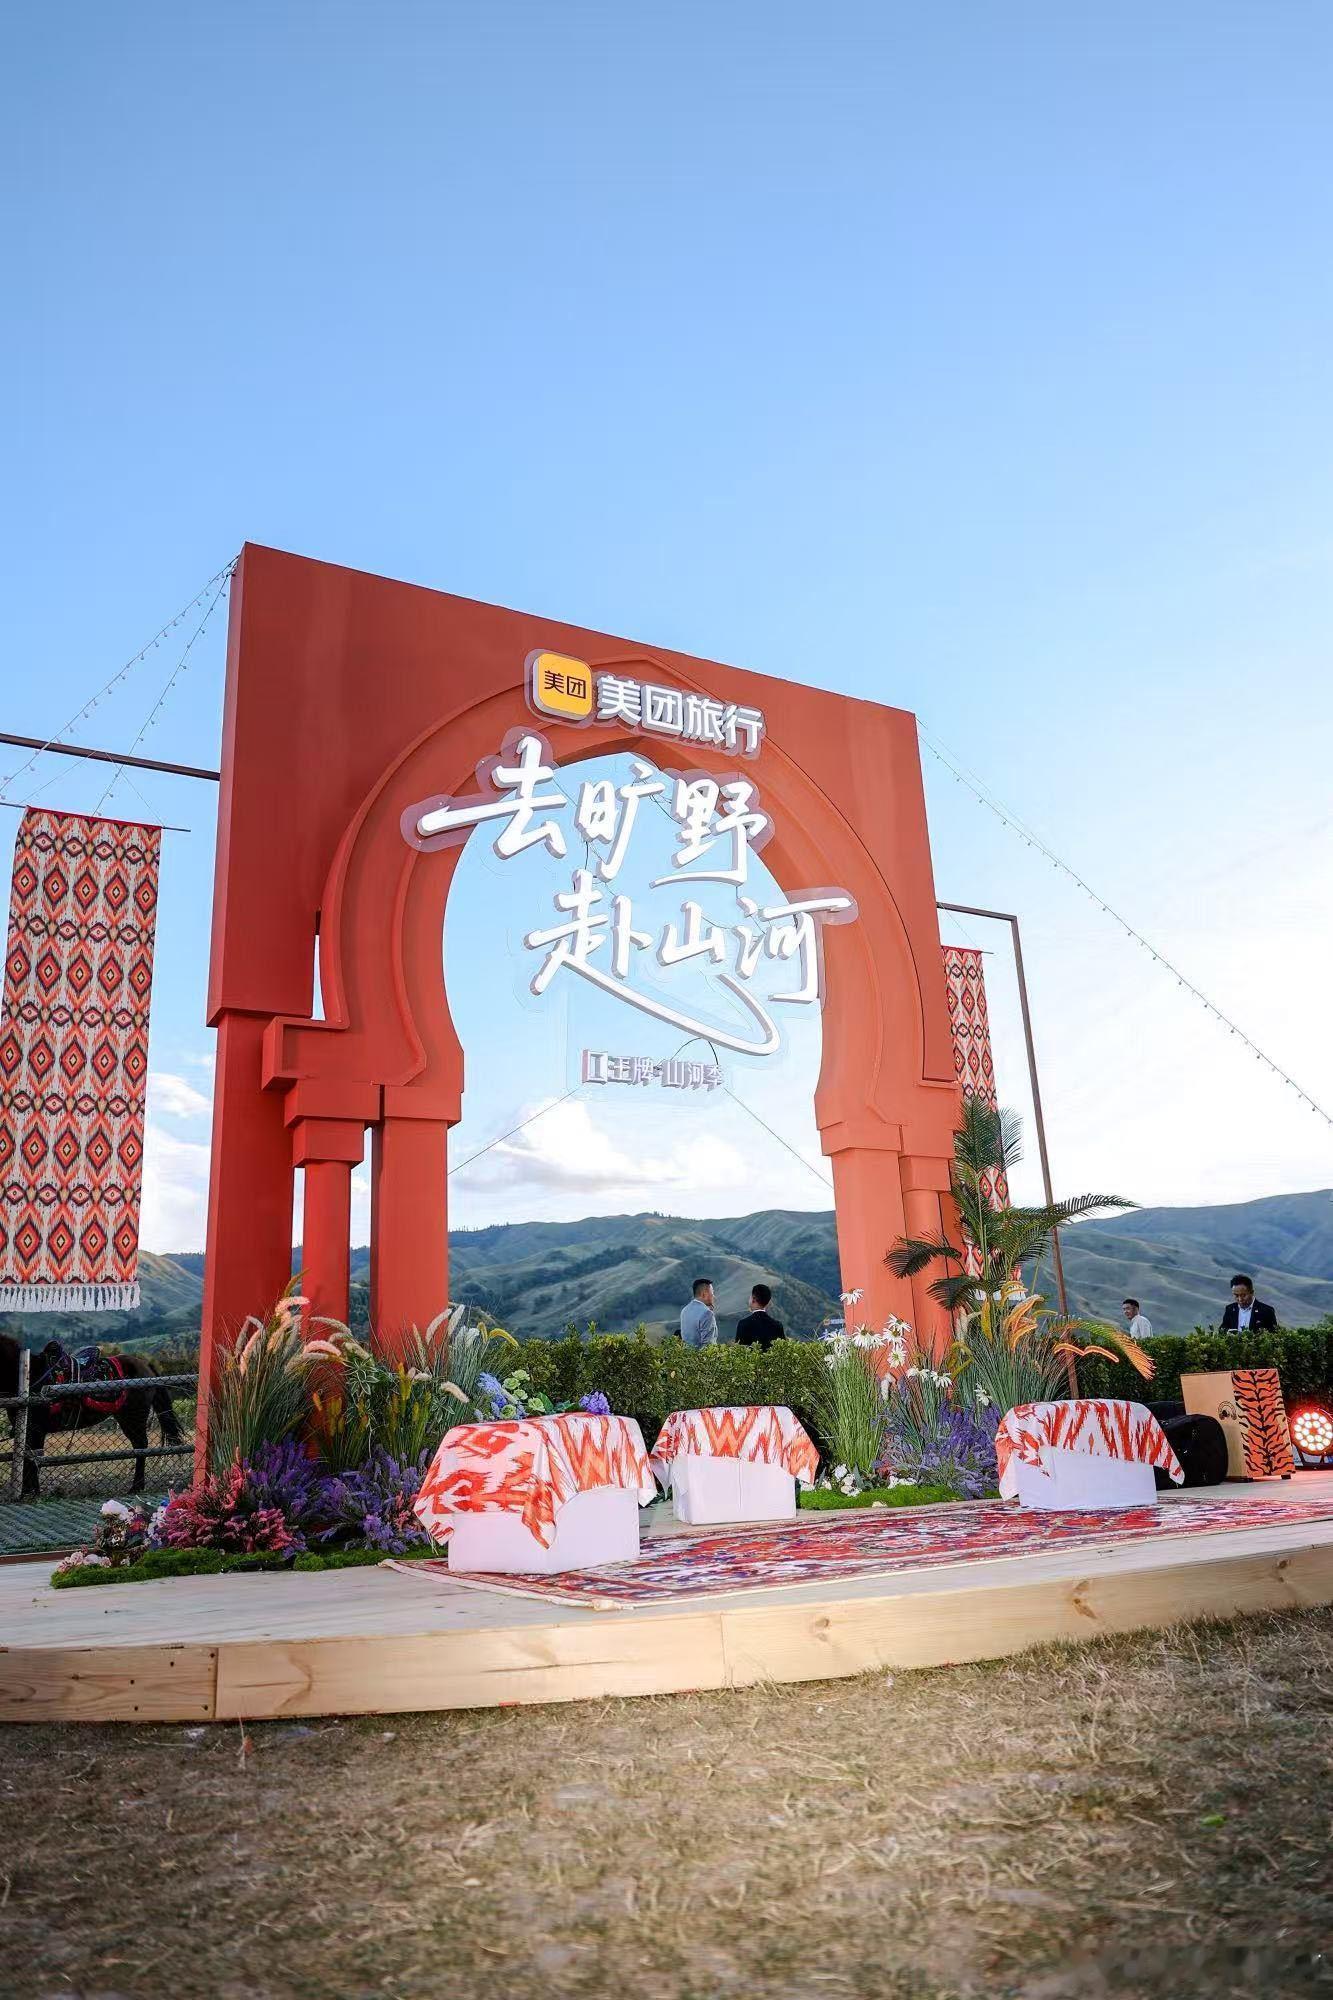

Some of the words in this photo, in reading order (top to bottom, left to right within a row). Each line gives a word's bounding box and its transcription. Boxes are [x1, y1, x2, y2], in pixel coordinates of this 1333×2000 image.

[544, 670, 586, 699] 美团
[597, 675, 763, 752] 美团旅行
[417, 735, 768, 887] 去旷野
[524, 869, 852, 1056] 赴山河
